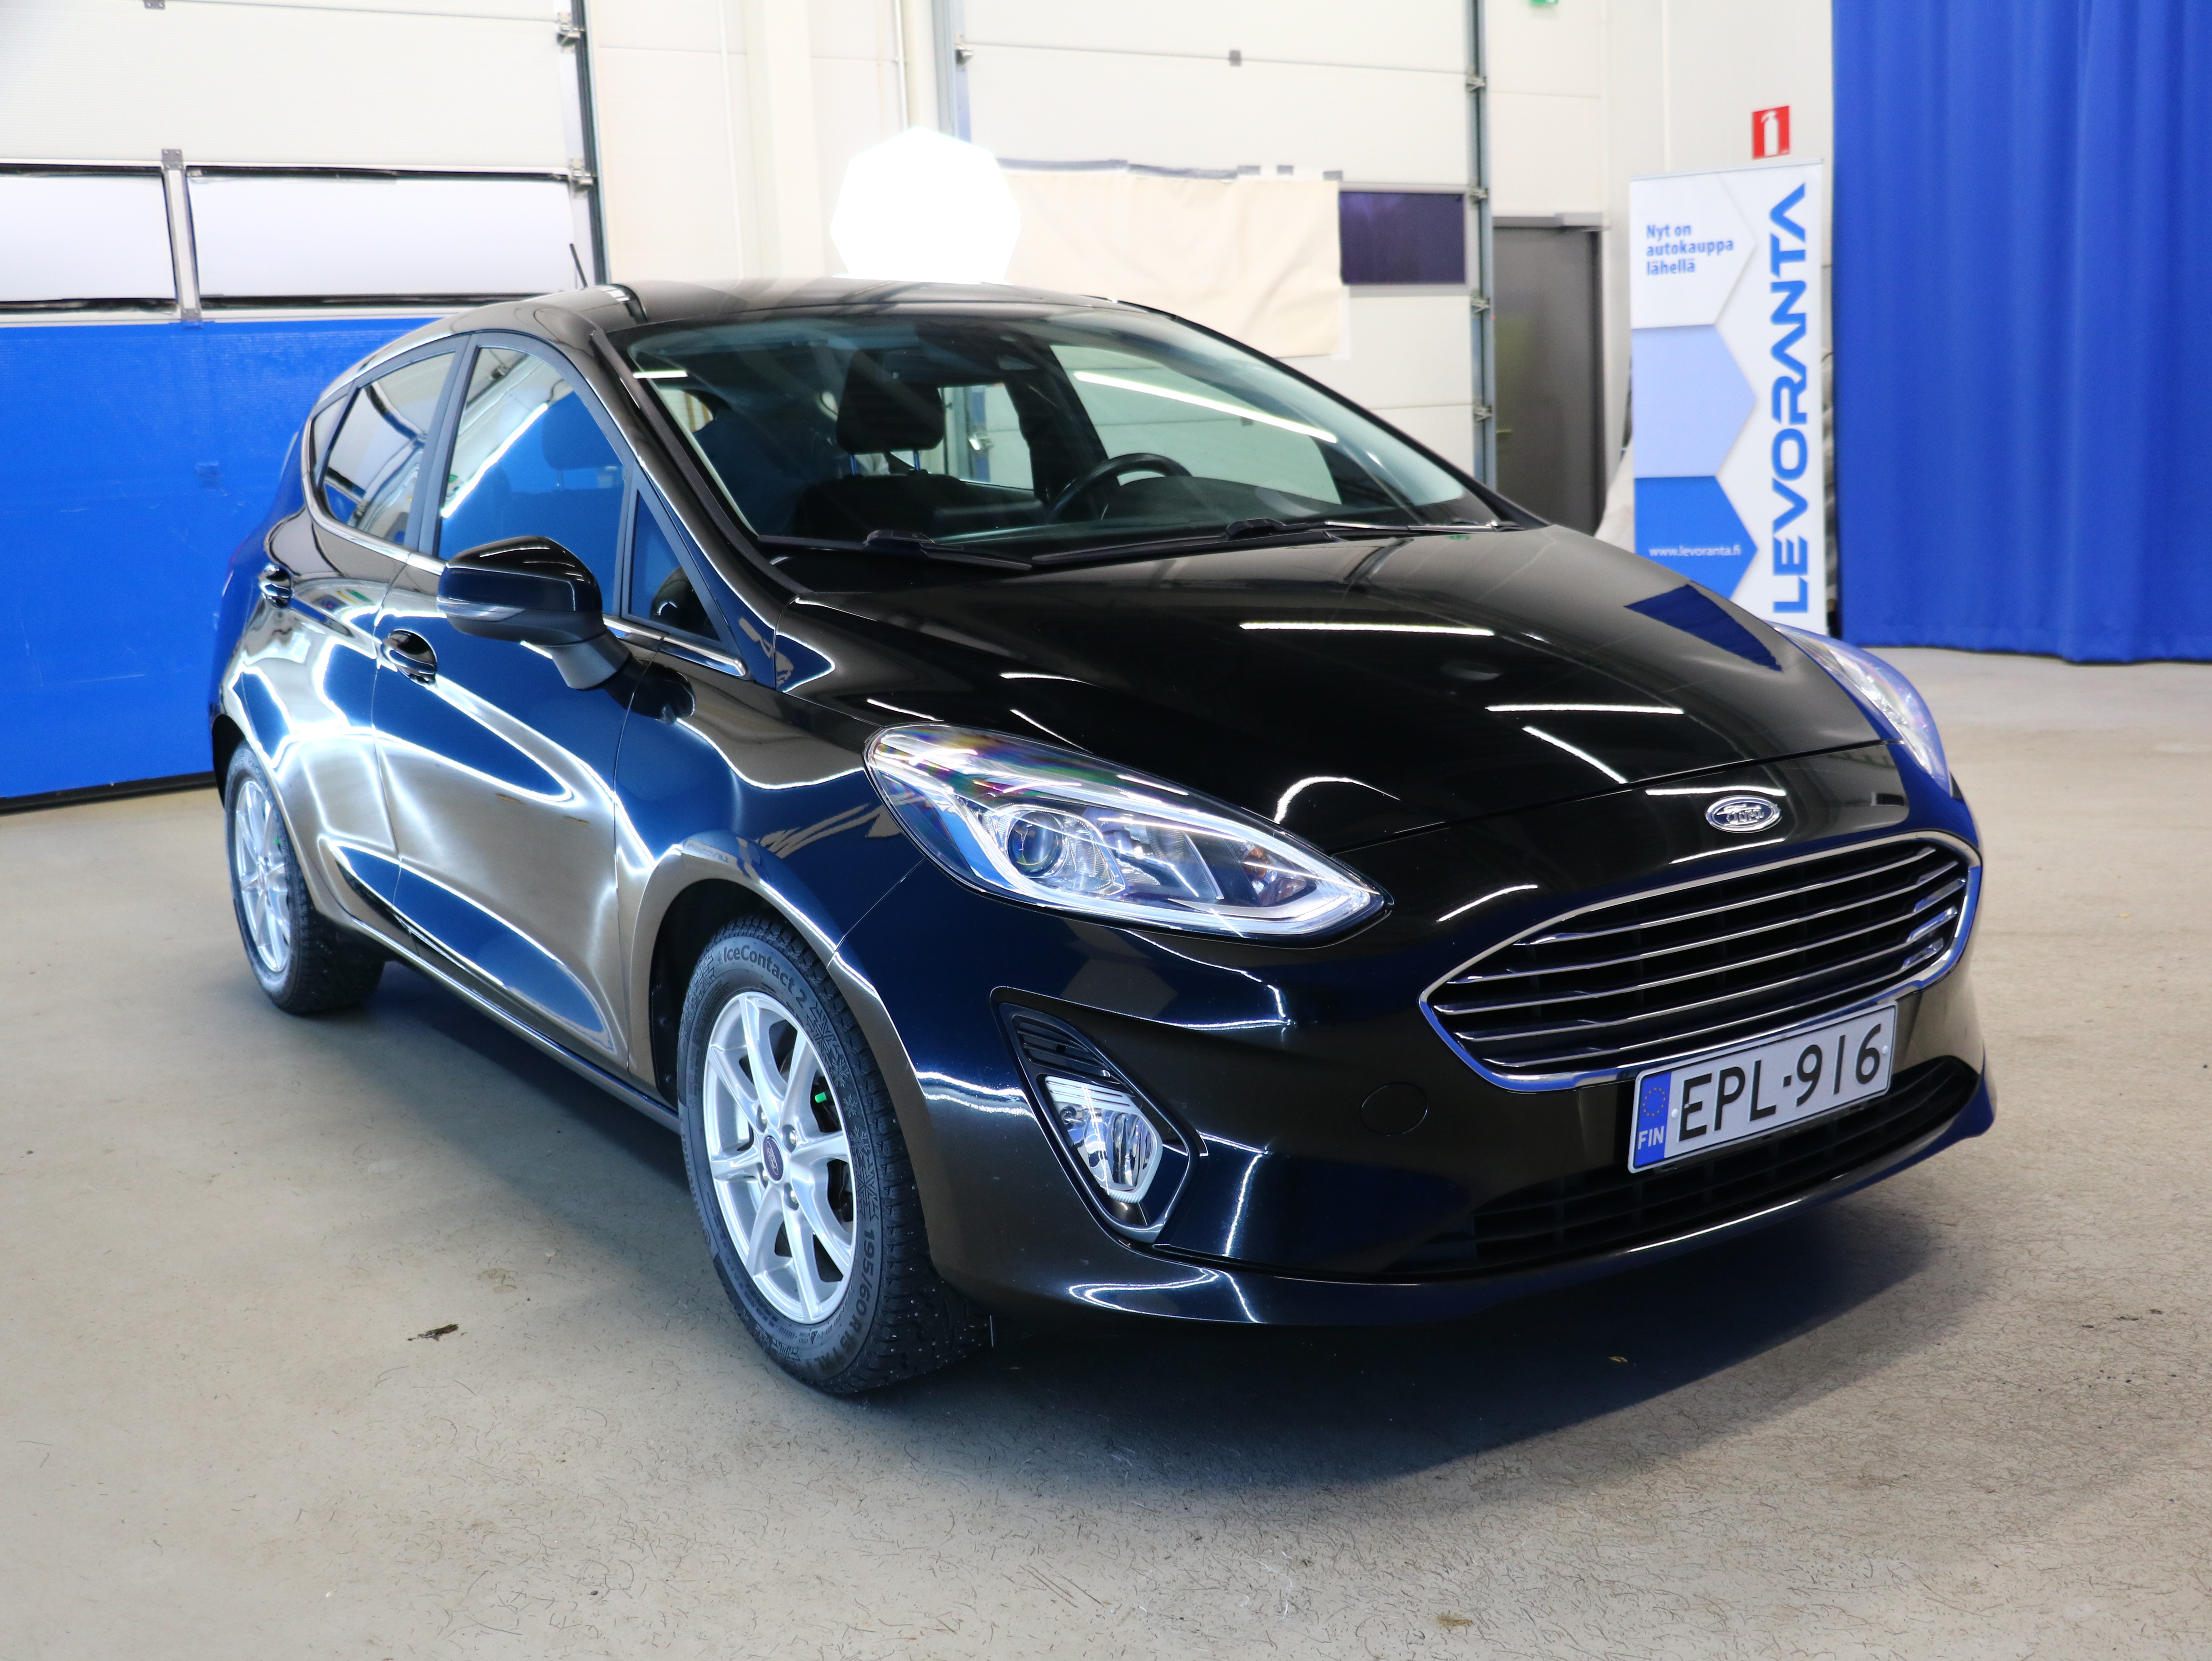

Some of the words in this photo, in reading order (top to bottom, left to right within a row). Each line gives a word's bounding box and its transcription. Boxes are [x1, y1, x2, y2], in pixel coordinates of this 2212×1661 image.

[1647, 225, 1671, 242] Nyt
[1674, 225, 1692, 236] on
[1647, 240, 1734, 256] autokauppa
[1647, 258, 1696, 275] lähellä
[1770, 184, 1808, 613] LEVORANTA
[1649, 544, 1742, 556] www.levoranta.fi
[1716, 803, 1765, 826] Ford
[723, 944, 795, 994] IceContact
[795, 988, 807, 1009] 2
[1679, 1023, 1882, 1142] EPL-916
[1637, 1125, 1664, 1150] FIN
[856, 1228, 876, 1316] 195/60
[849, 1313, 863, 1334] R
